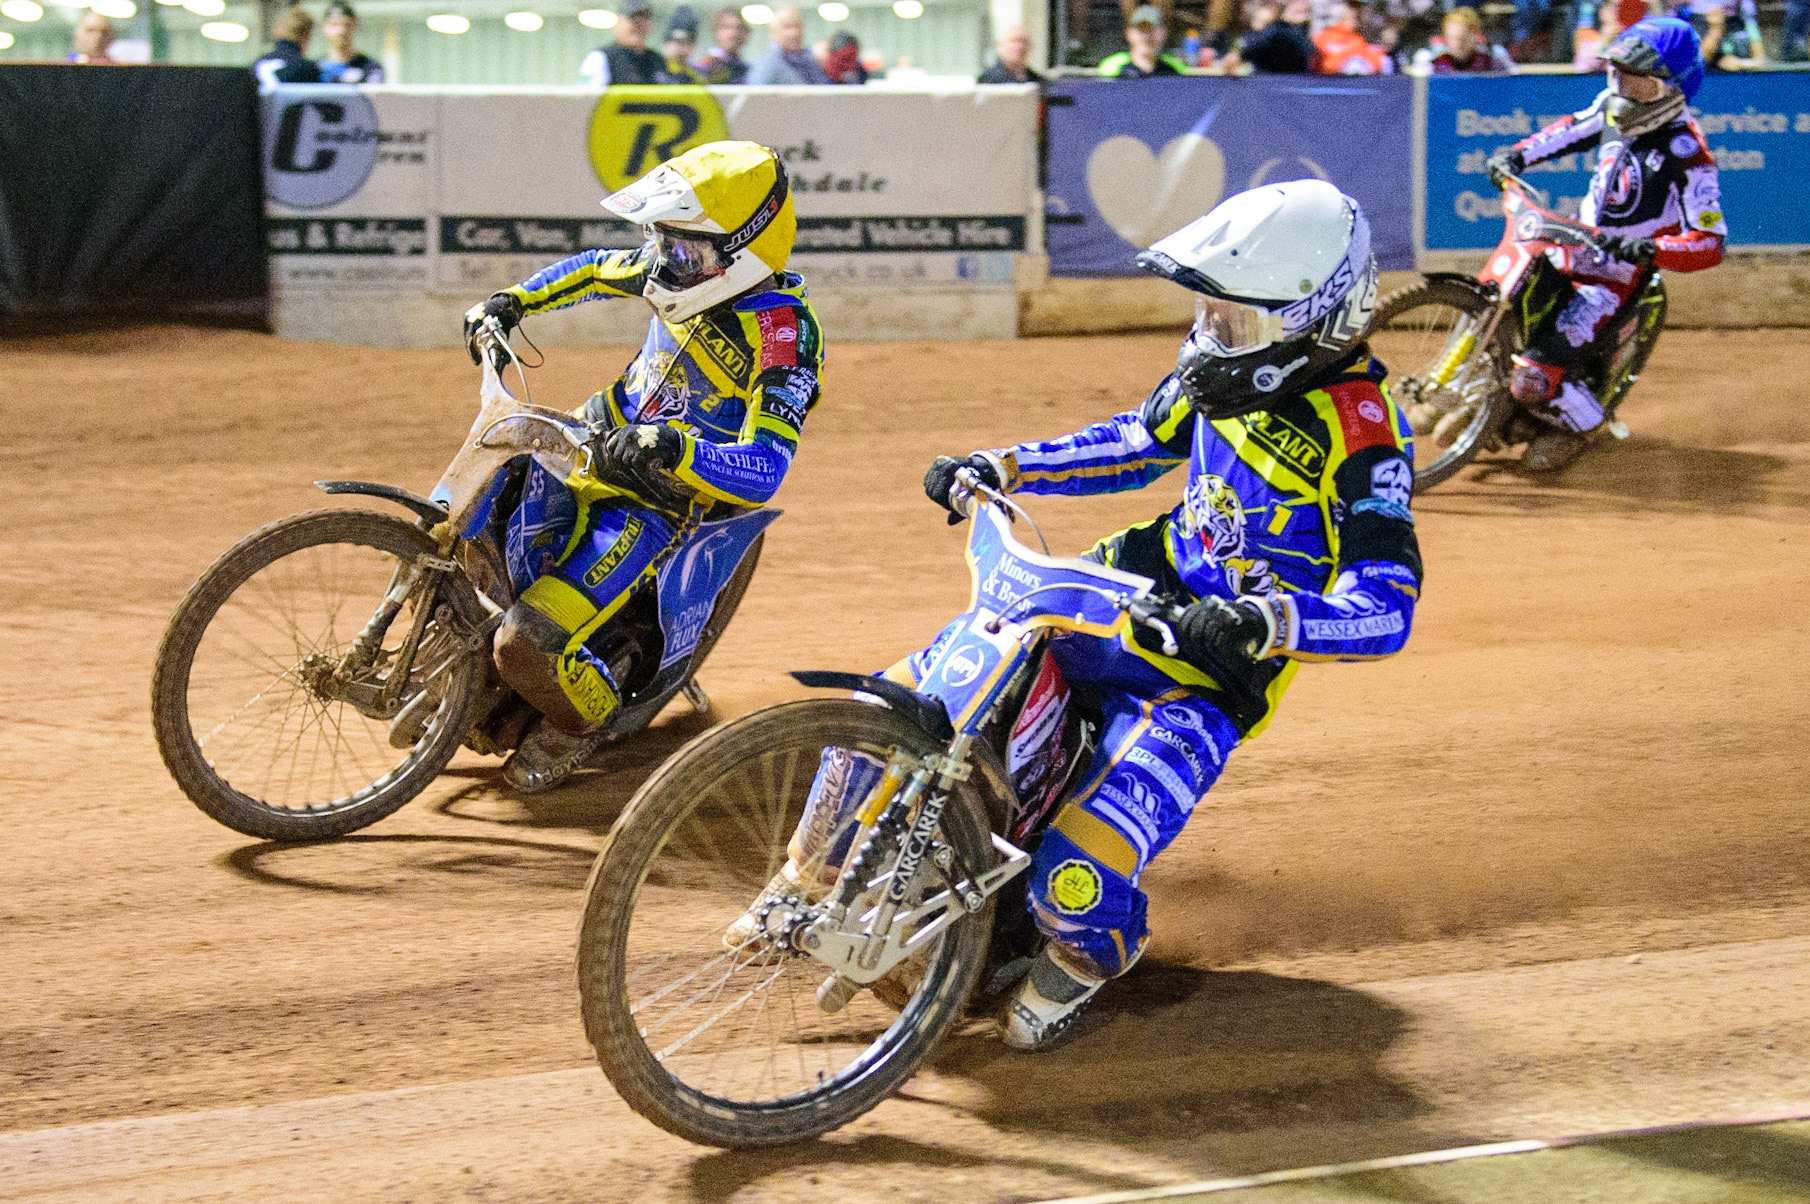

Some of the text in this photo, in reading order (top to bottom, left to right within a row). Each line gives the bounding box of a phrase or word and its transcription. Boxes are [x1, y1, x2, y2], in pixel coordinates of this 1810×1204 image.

[1456, 109, 1532, 136] Book
[981, 569, 1001, 597] &
[994, 552, 1042, 589] Minors
[889, 793, 949, 901] GARCAREK
